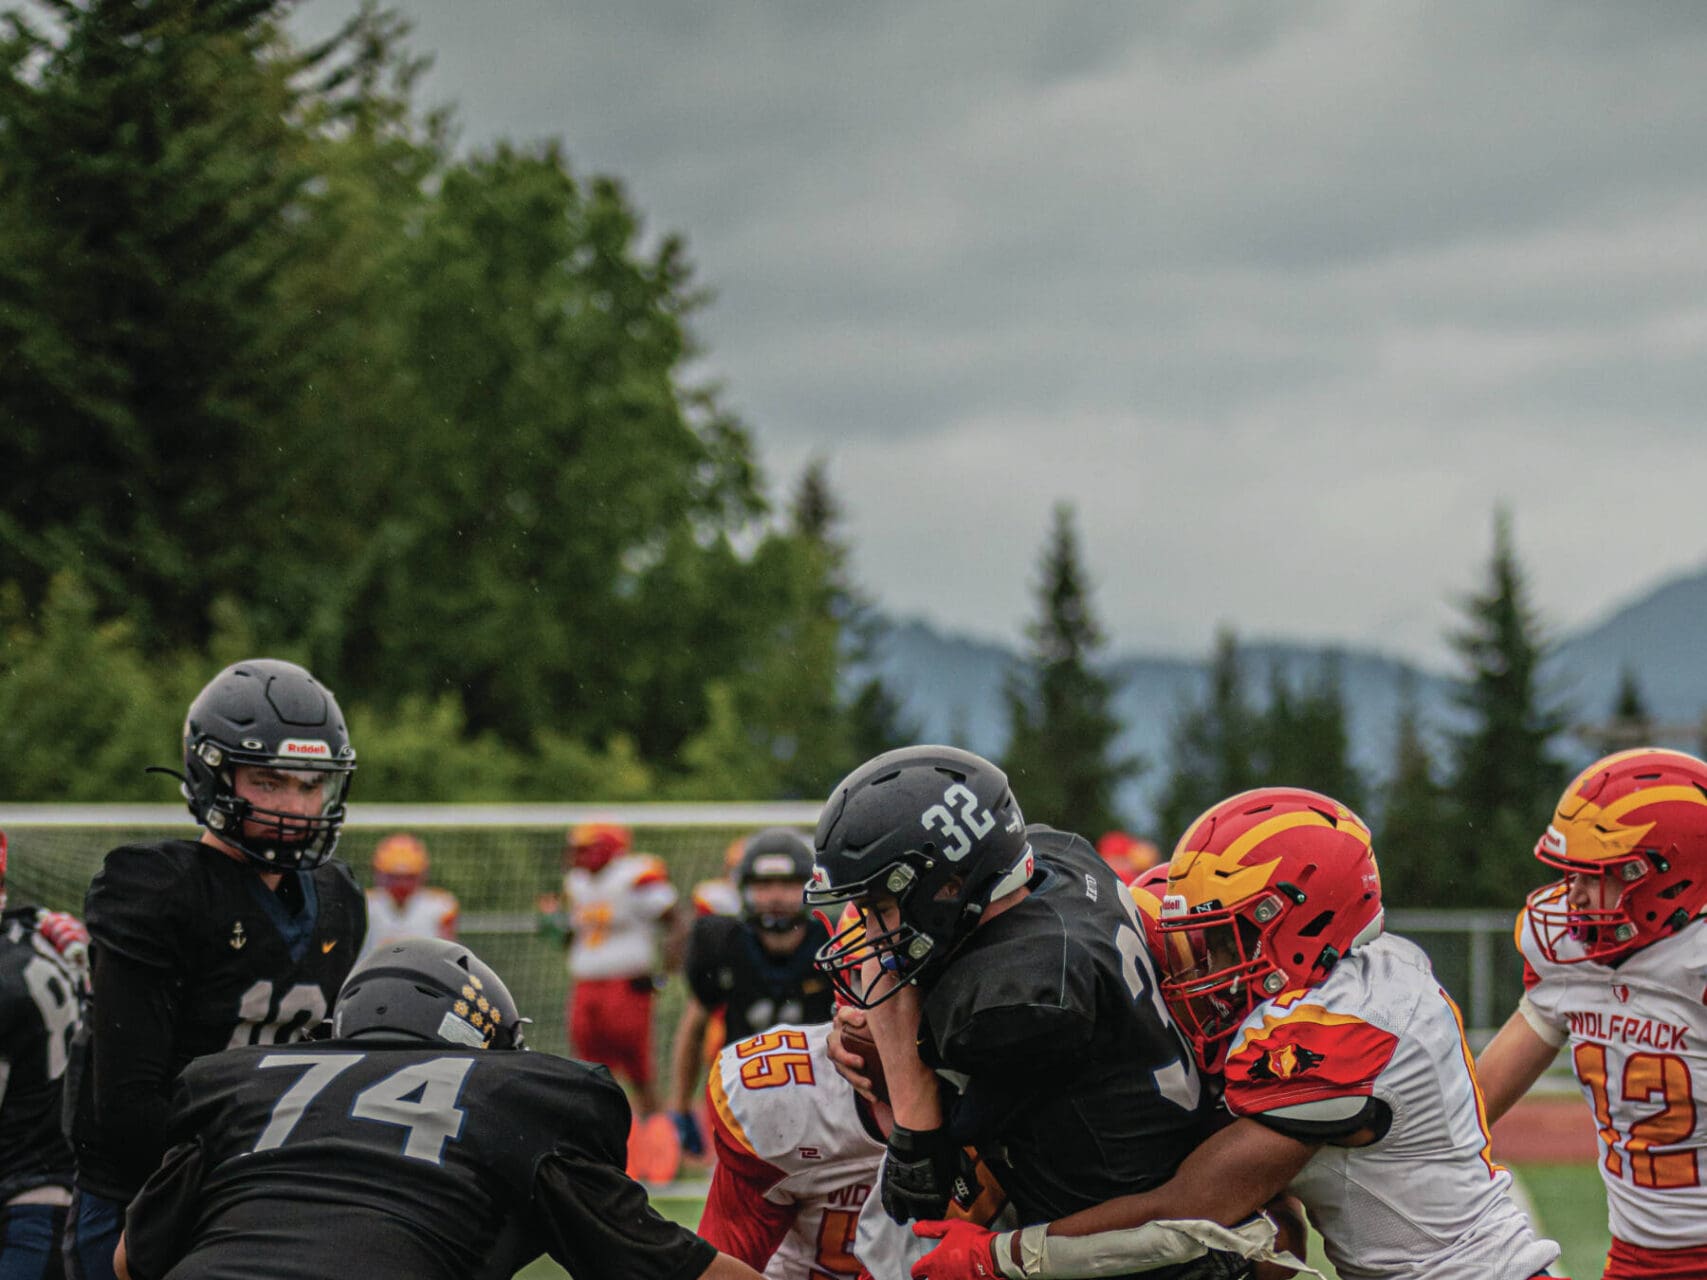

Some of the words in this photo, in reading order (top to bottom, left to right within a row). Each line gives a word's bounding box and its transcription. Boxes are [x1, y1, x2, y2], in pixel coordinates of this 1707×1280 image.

[921, 783, 995, 862] 32
[735, 1029, 816, 1090] 55
[1565, 1012, 1689, 1051] WOLFPACK
[258, 1053, 476, 1167] 74
[1573, 1041, 1700, 1190] 12
